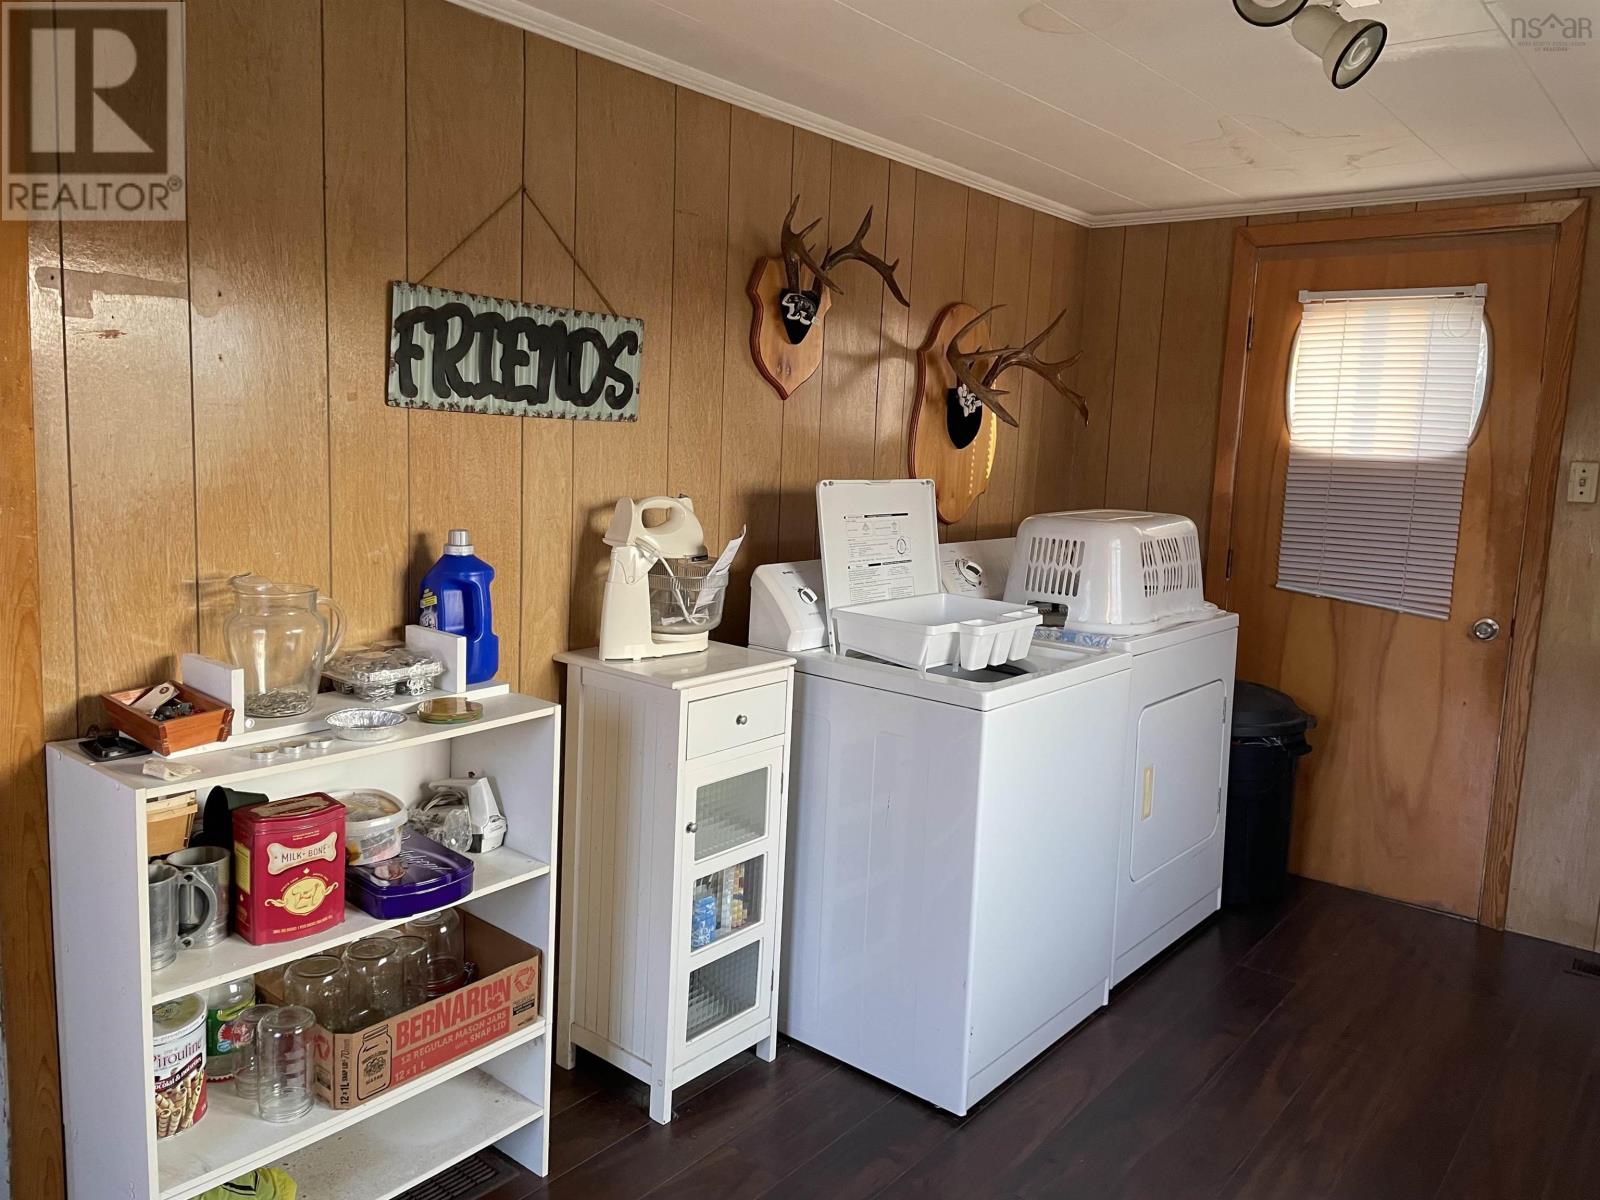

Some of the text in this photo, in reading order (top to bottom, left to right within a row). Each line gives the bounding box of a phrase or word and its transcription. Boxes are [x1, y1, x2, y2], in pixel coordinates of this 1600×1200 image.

[394, 302, 639, 410] FRIENDS
[396, 975, 512, 1051] BERNARDIN
[414, 1034, 454, 1059] REGULAR
[455, 1020, 486, 1041] MASON
[487, 1009, 507, 1026] JARS
[470, 1026, 491, 1043] SNAP
[493, 1020, 507, 1034] LID
